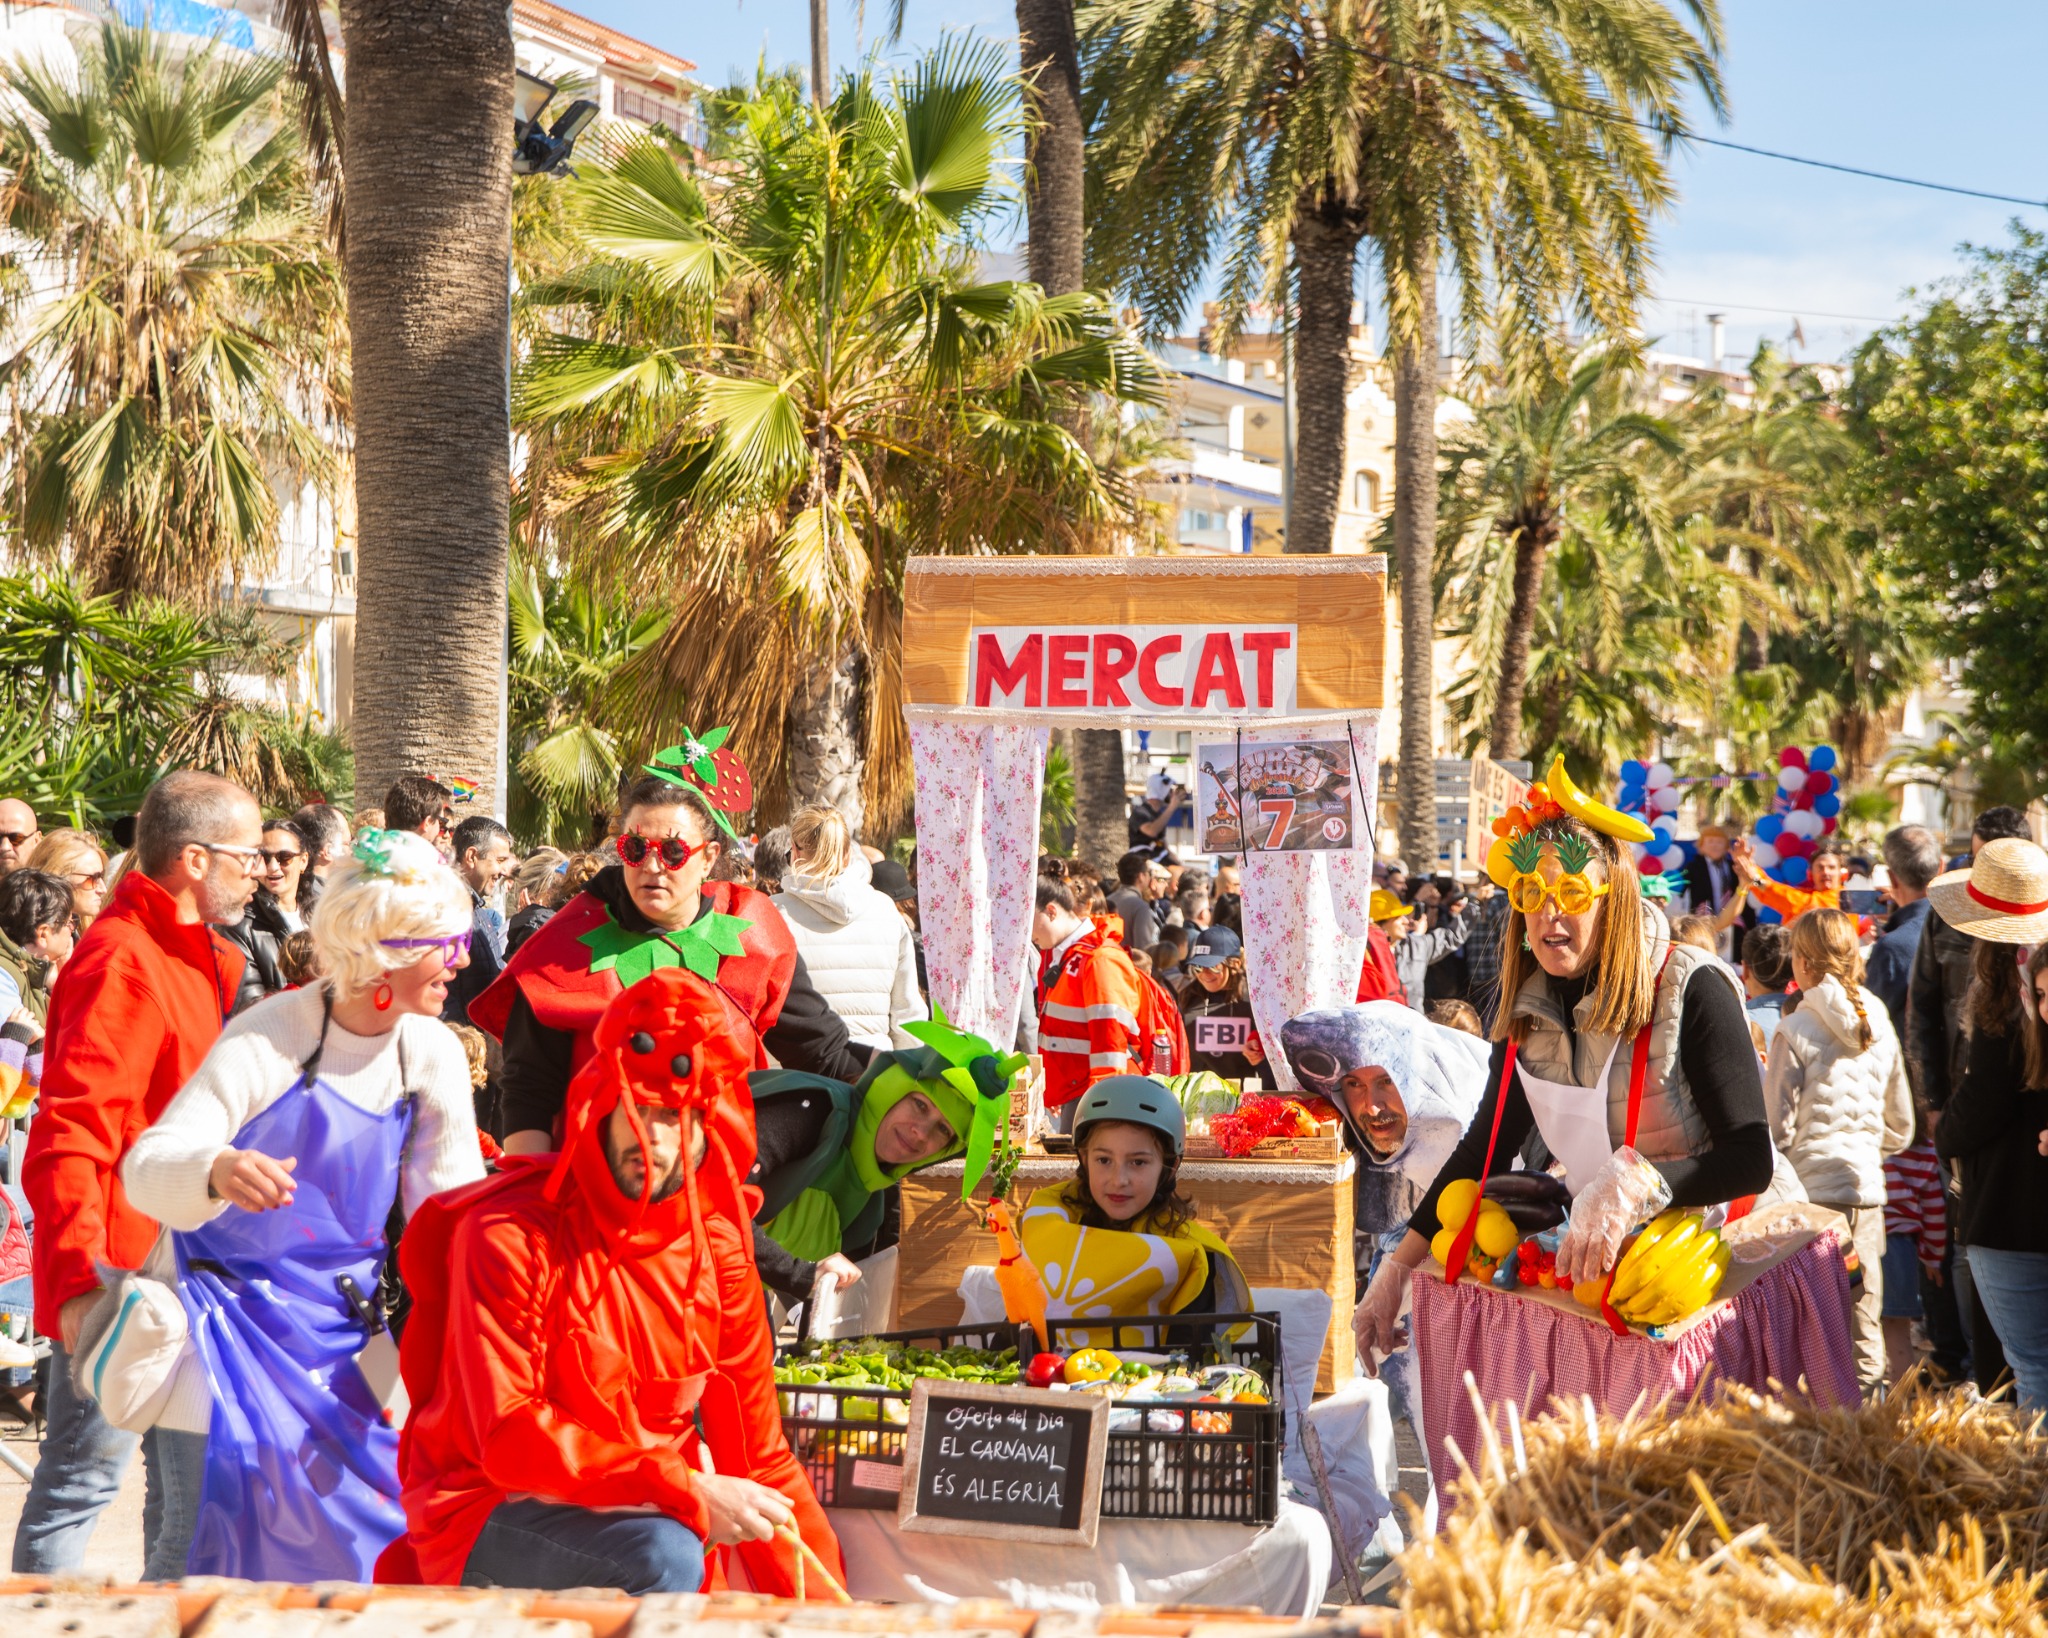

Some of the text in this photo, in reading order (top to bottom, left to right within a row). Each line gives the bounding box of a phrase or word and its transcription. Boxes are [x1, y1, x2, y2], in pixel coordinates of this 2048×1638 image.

[975, 631, 1290, 709] MERCAT
[1259, 799, 1297, 850] 7
[1198, 1023, 1245, 1045] FBI
[945, 1406, 1002, 1431] Oferta
[1007, 1408, 1027, 1431] del
[939, 1436, 1066, 1471] EL CARNAVAL
[932, 1467, 956, 1495] ÉS
